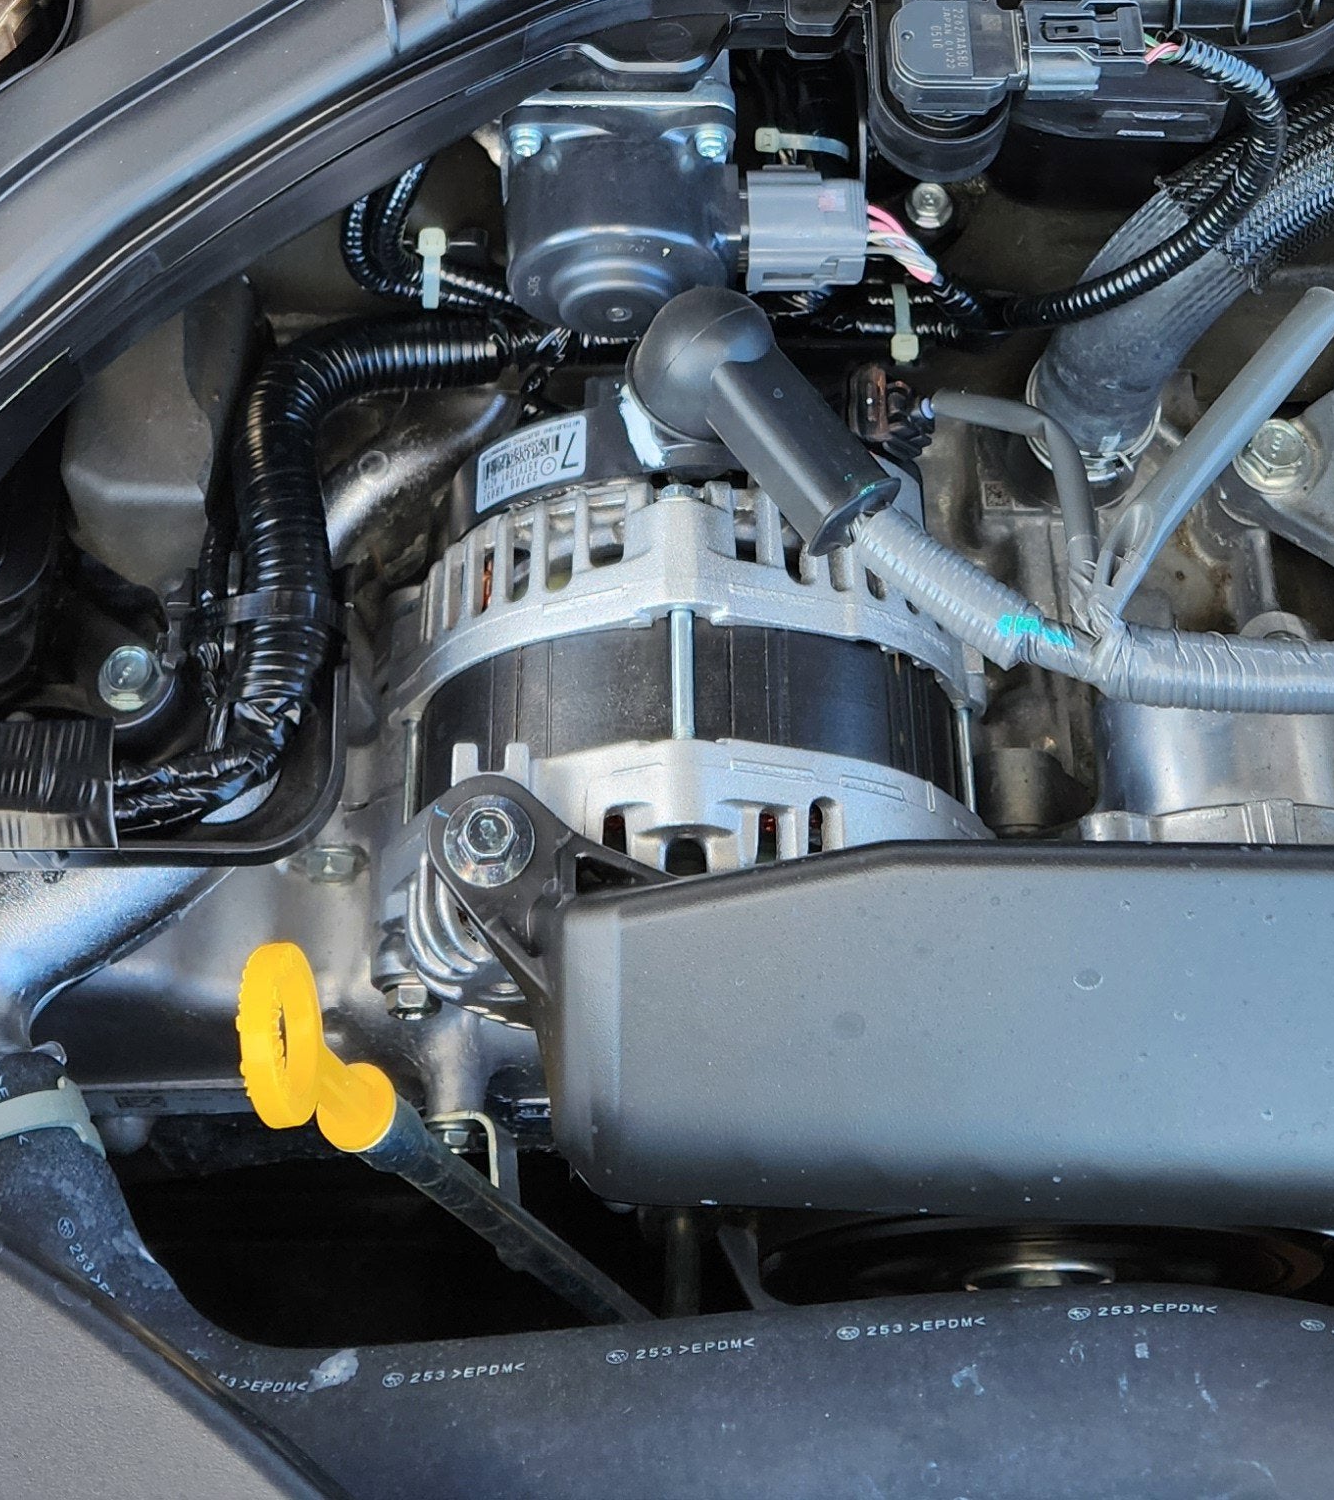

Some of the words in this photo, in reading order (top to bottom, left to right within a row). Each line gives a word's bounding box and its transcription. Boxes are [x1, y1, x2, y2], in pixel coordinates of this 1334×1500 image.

[942, 6, 952, 35] JAPAN
[930, 25, 944, 49] 0510
[953, 8, 969, 67] 22627AA580
[561, 431, 579, 470] 7
[69, 1242, 95, 1273] 253
[89, 1272, 116, 1299] >E
[1097, 1305, 1135, 1317] 253
[1139, 1303, 1218, 1315] >EPDM<
[866, 1323, 903, 1337] 253
[909, 1316, 987, 1332] >EPDM<
[635, 1346, 673, 1360] 253
[678, 1338, 755, 1355] >EPDM<
[409, 1370, 446, 1384] 253
[451, 1362, 526, 1380] >EPDM<
[238, 1380, 309, 1394] >EPDM<
